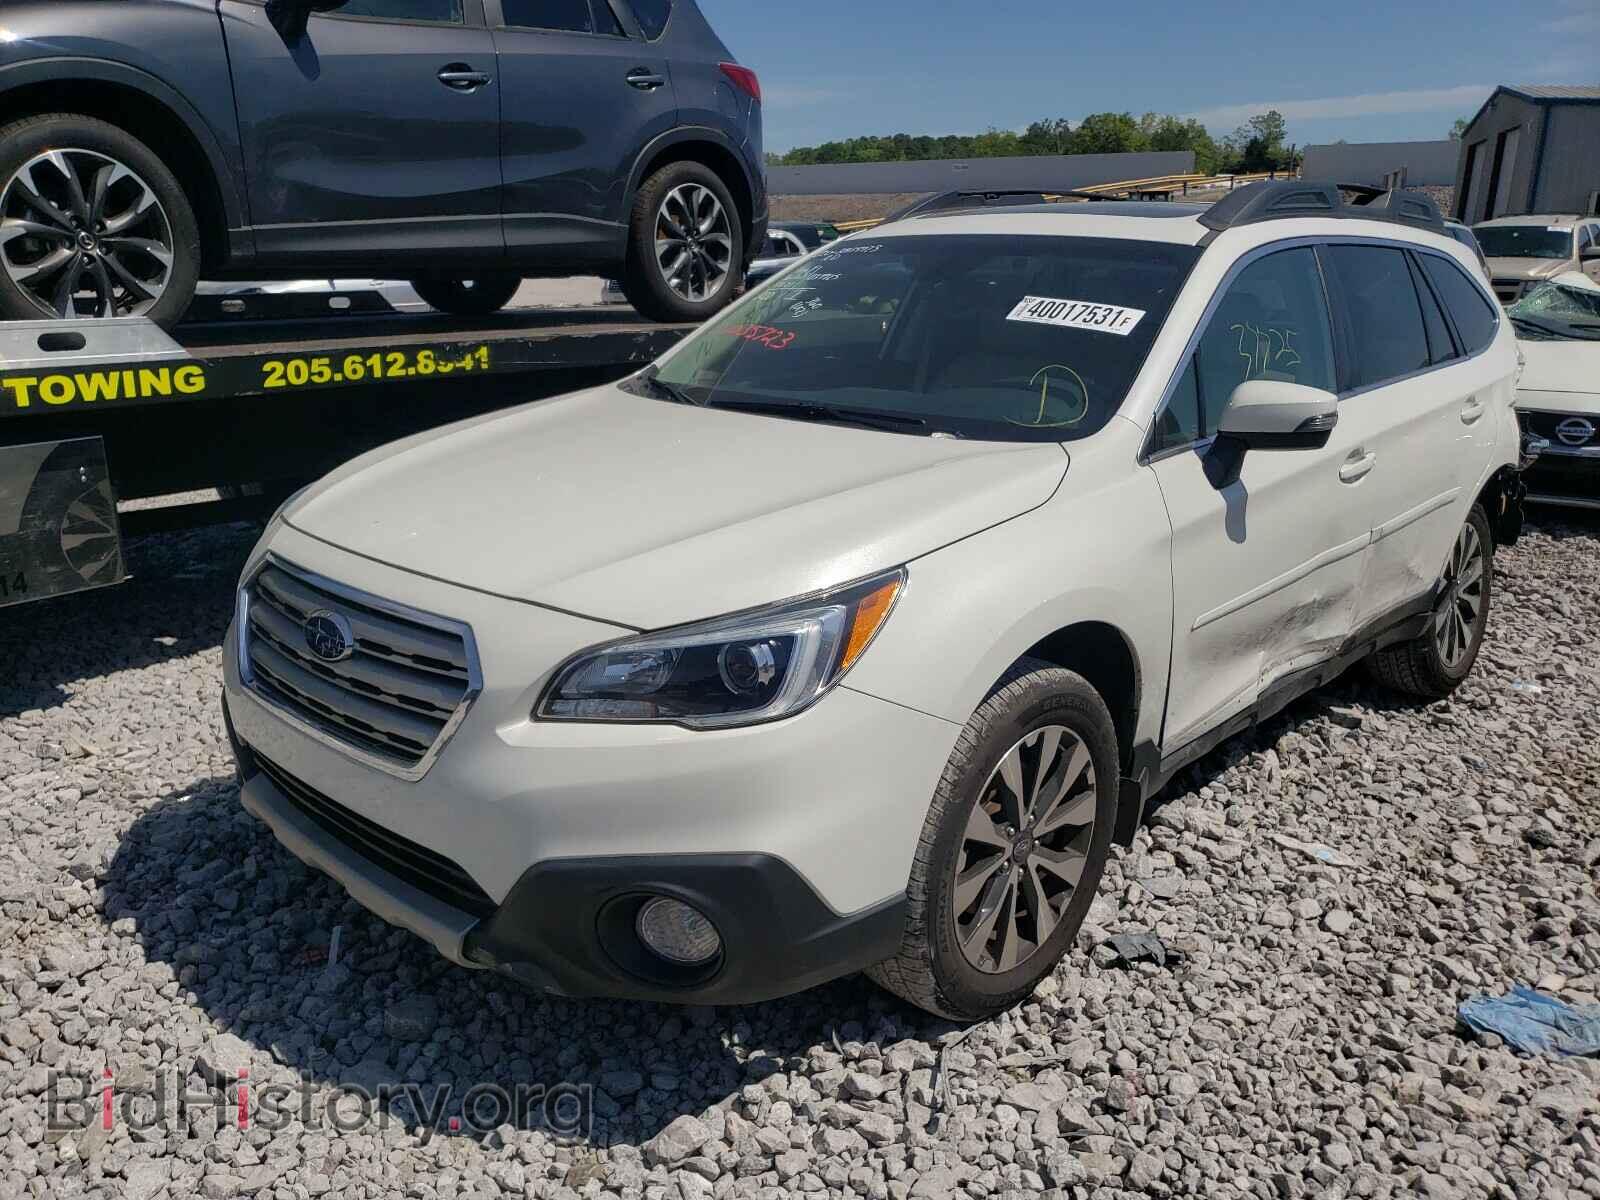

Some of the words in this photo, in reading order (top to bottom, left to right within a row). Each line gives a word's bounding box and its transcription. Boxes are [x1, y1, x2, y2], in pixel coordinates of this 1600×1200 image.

[1027, 300, 1123, 327] 40017531
[1120, 316, 1131, 327] F
[2, 365, 206, 407] TOWING
